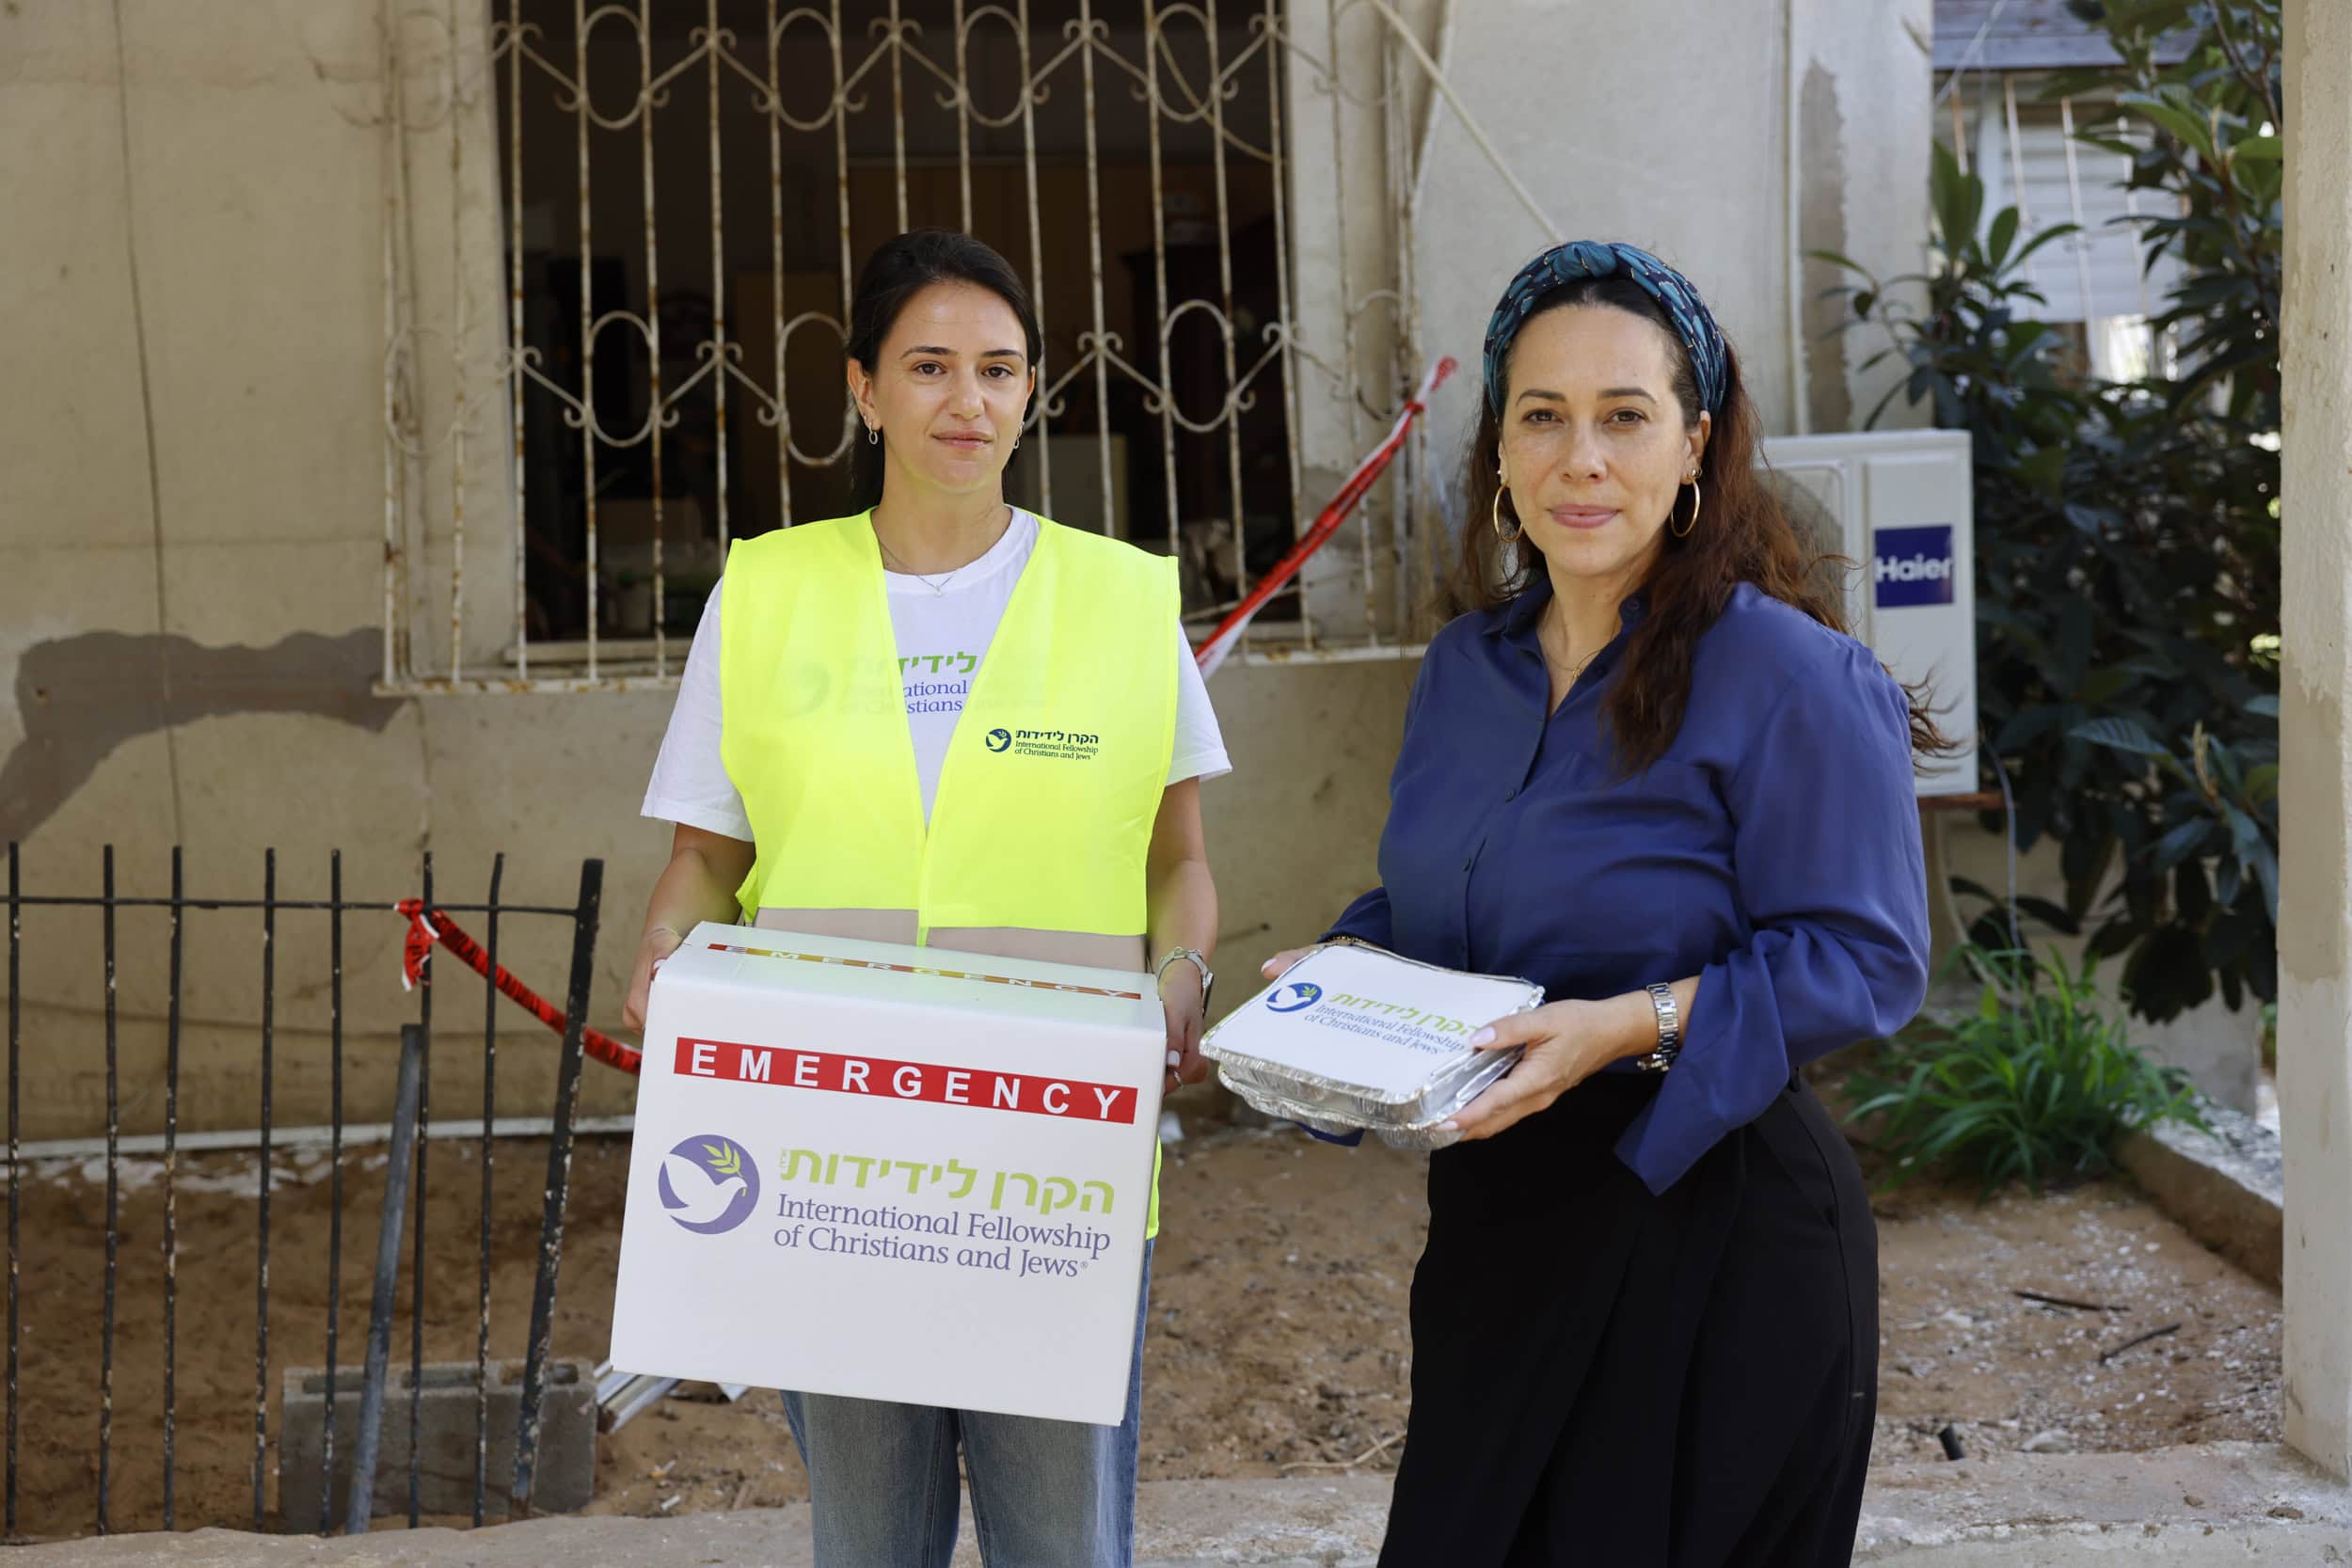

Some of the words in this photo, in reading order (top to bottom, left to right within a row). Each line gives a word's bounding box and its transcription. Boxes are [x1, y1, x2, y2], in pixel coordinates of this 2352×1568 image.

[1875, 552, 1952, 582] Haier
[903, 680, 968, 698] ational
[906, 699, 963, 714] stians
[1015, 740, 1061, 751] International
[1062, 743, 1099, 755] Fellowship
[1016, 730, 1065, 741] לידידות
[1068, 733, 1099, 745] הקרן
[1023, 748, 1059, 758] Christians
[1075, 752, 1091, 761] Jews
[1328, 992, 1422, 1020] לידידות
[1304, 1013, 1321, 1026] of
[1317, 1016, 1381, 1039] Christians
[1381, 1031, 1411, 1049] and
[1409, 1038, 1438, 1054] Jews
[1316, 1004, 1399, 1031] International
[1396, 1022, 1466, 1053] Fellowship
[691, 1043, 1121, 1120] EMERGENCY
[780, 1148, 978, 1199] לידידות
[990, 1171, 1114, 1215] הקרן
[776, 1193, 960, 1236] International
[967, 1212, 1110, 1260] Fellowship
[773, 1224, 804, 1248] of
[808, 1227, 949, 1265] Christians
[956, 1246, 1011, 1271] and
